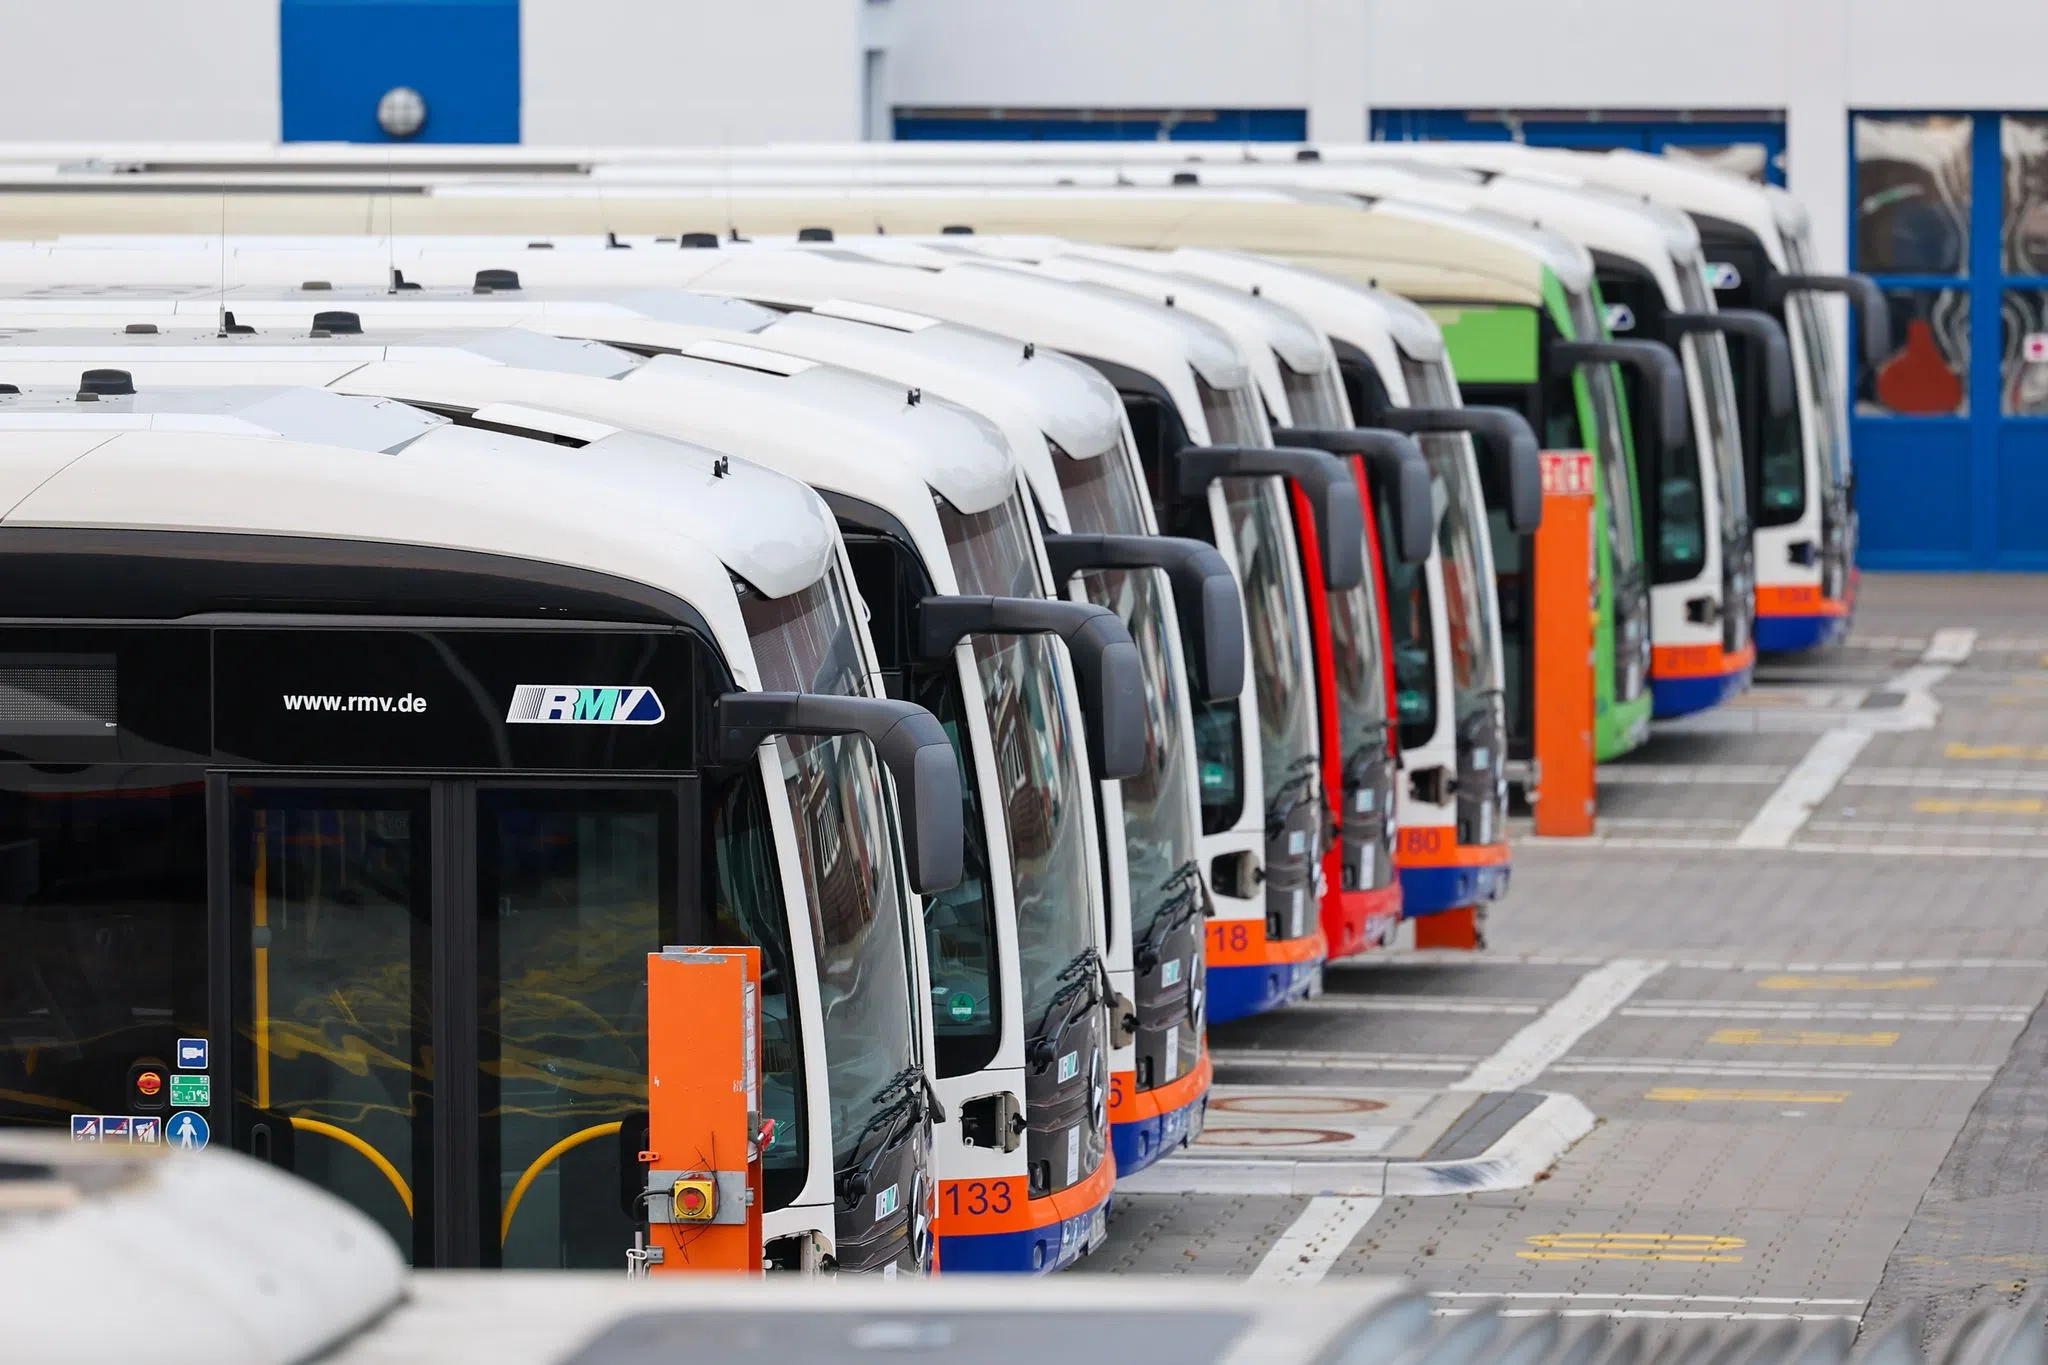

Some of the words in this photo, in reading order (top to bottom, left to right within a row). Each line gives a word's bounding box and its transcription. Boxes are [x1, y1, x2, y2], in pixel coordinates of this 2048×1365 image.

[283, 693, 427, 713] www.rmv.de
[535, 687, 651, 721] RMV
[1204, 924, 1248, 952] 18
[945, 1181, 1012, 1216] 133
